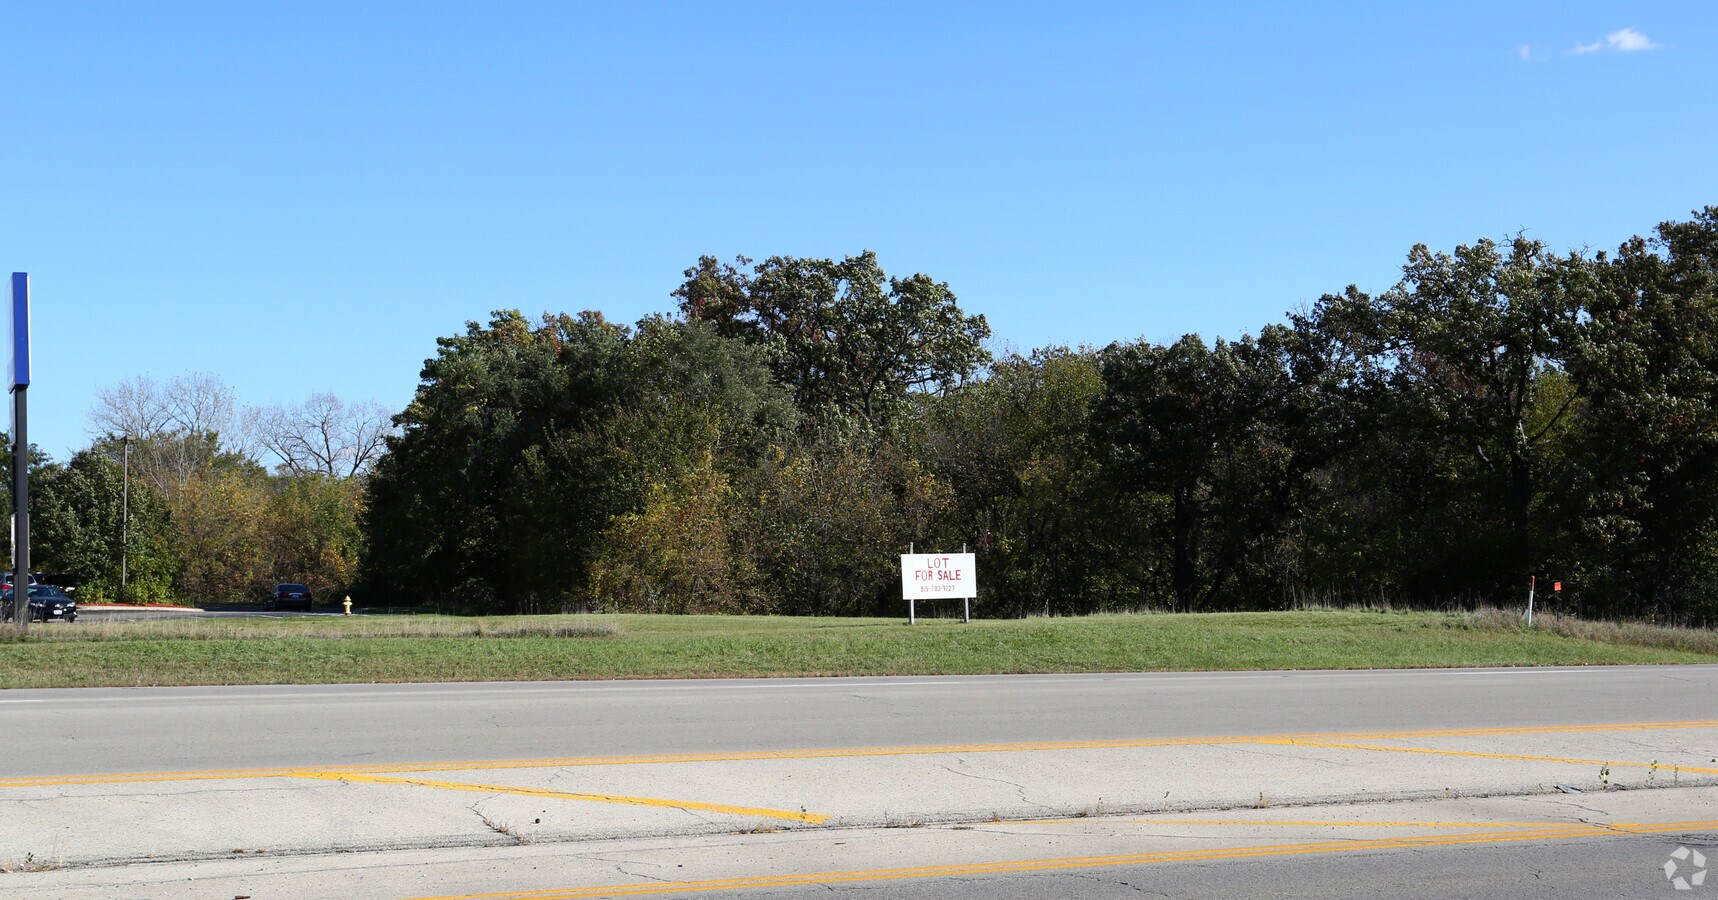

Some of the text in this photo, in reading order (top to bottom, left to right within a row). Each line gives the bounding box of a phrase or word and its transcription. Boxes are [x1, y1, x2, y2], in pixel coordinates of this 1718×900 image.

[927, 557, 949, 568] LOT
[915, 569, 961, 581] FOR SALE
